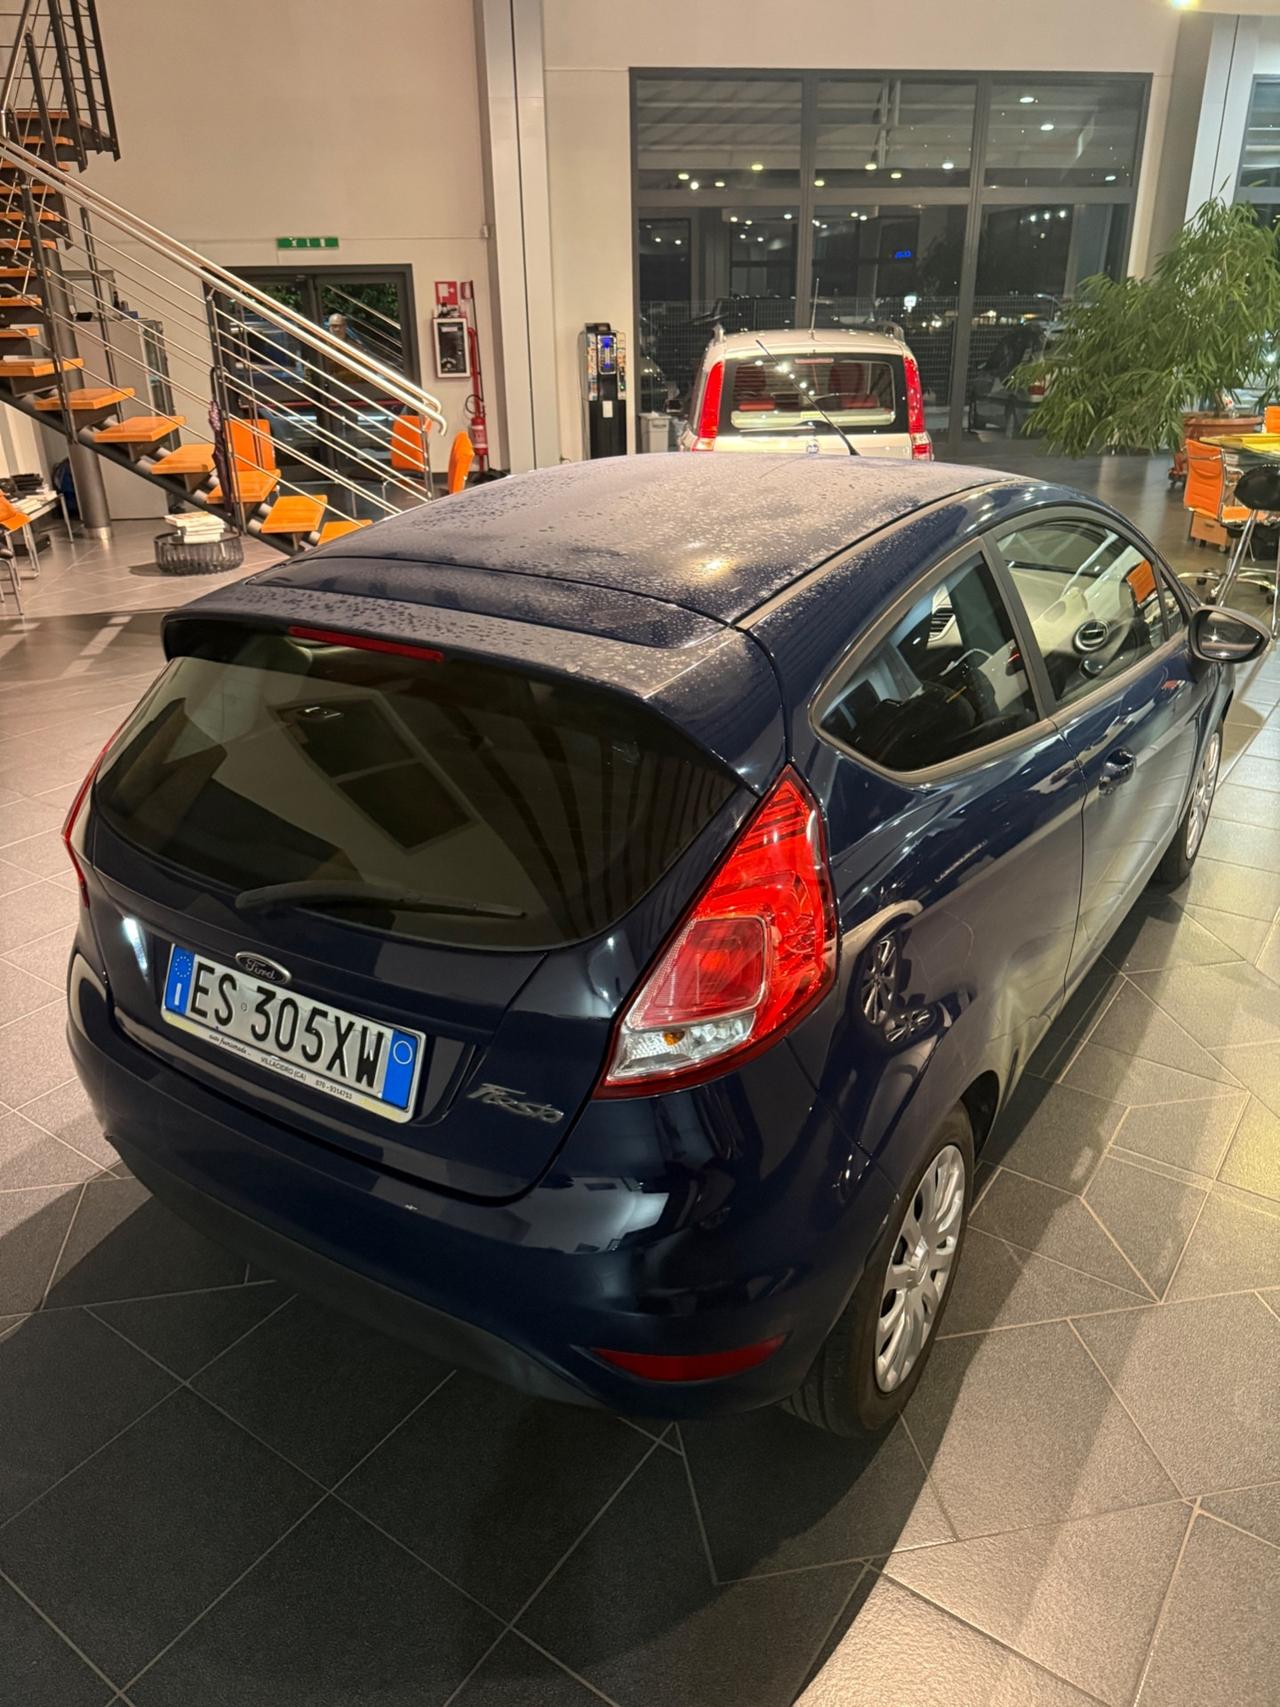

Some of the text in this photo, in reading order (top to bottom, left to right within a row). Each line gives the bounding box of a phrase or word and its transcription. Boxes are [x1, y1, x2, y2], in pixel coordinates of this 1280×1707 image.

[245, 958, 276, 981] Ford
[190, 961, 385, 1088] ES 305XW
[469, 1082, 565, 1124] Fiesta
